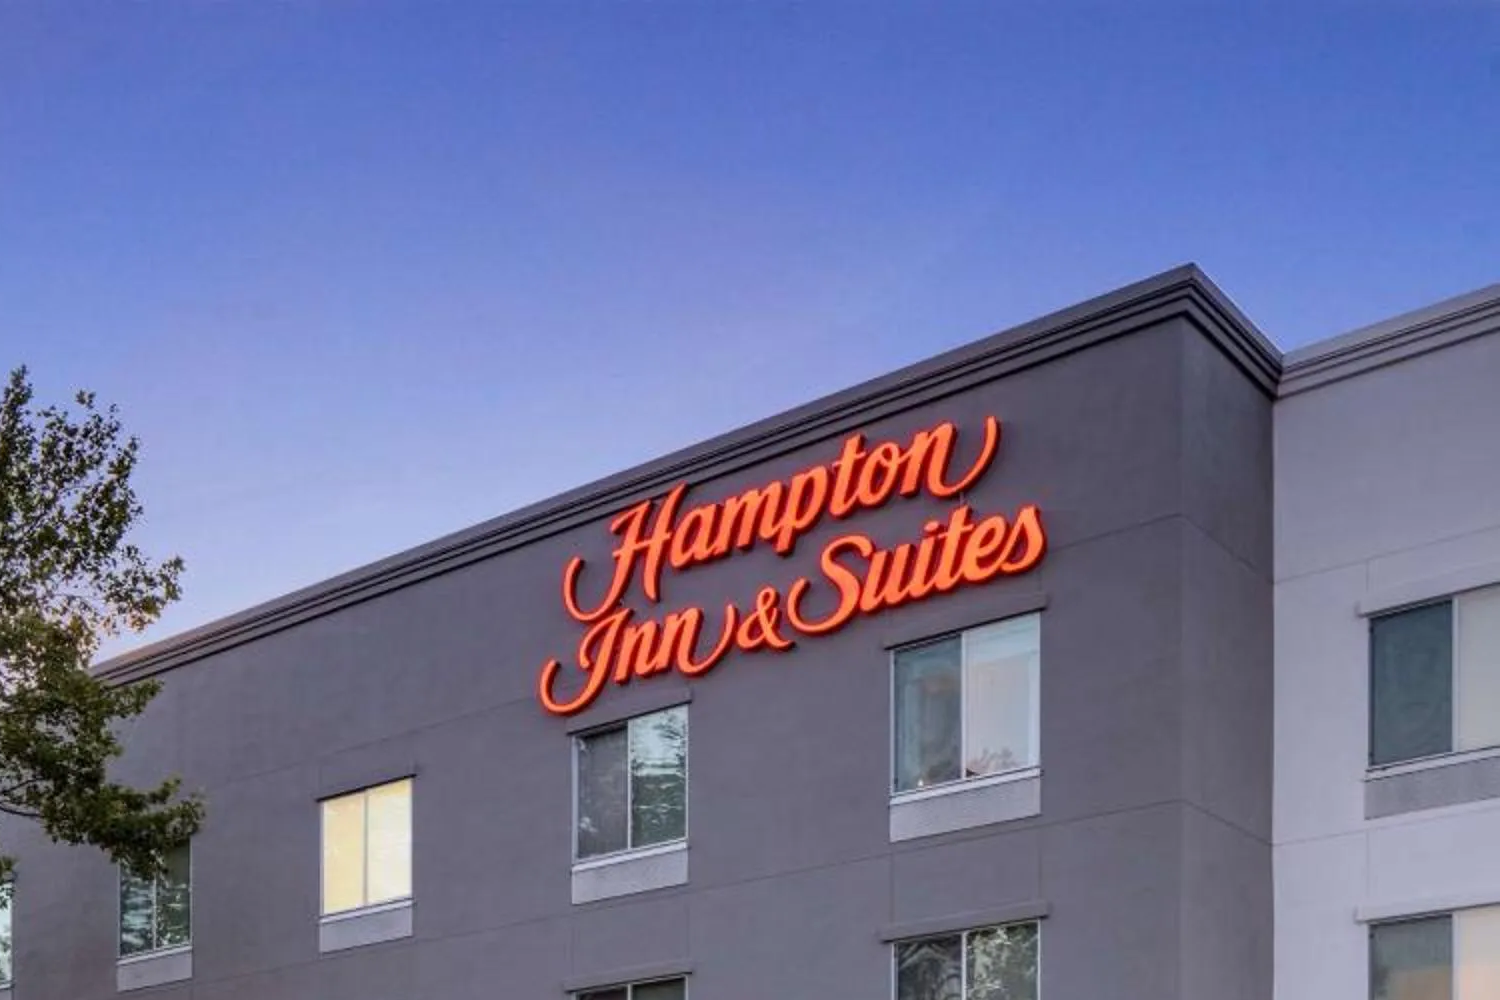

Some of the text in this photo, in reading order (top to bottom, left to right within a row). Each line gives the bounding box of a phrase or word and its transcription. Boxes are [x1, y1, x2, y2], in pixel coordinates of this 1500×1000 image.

[538, 503, 1046, 716] Inn & Suites
[563, 416, 999, 622] Hampton
